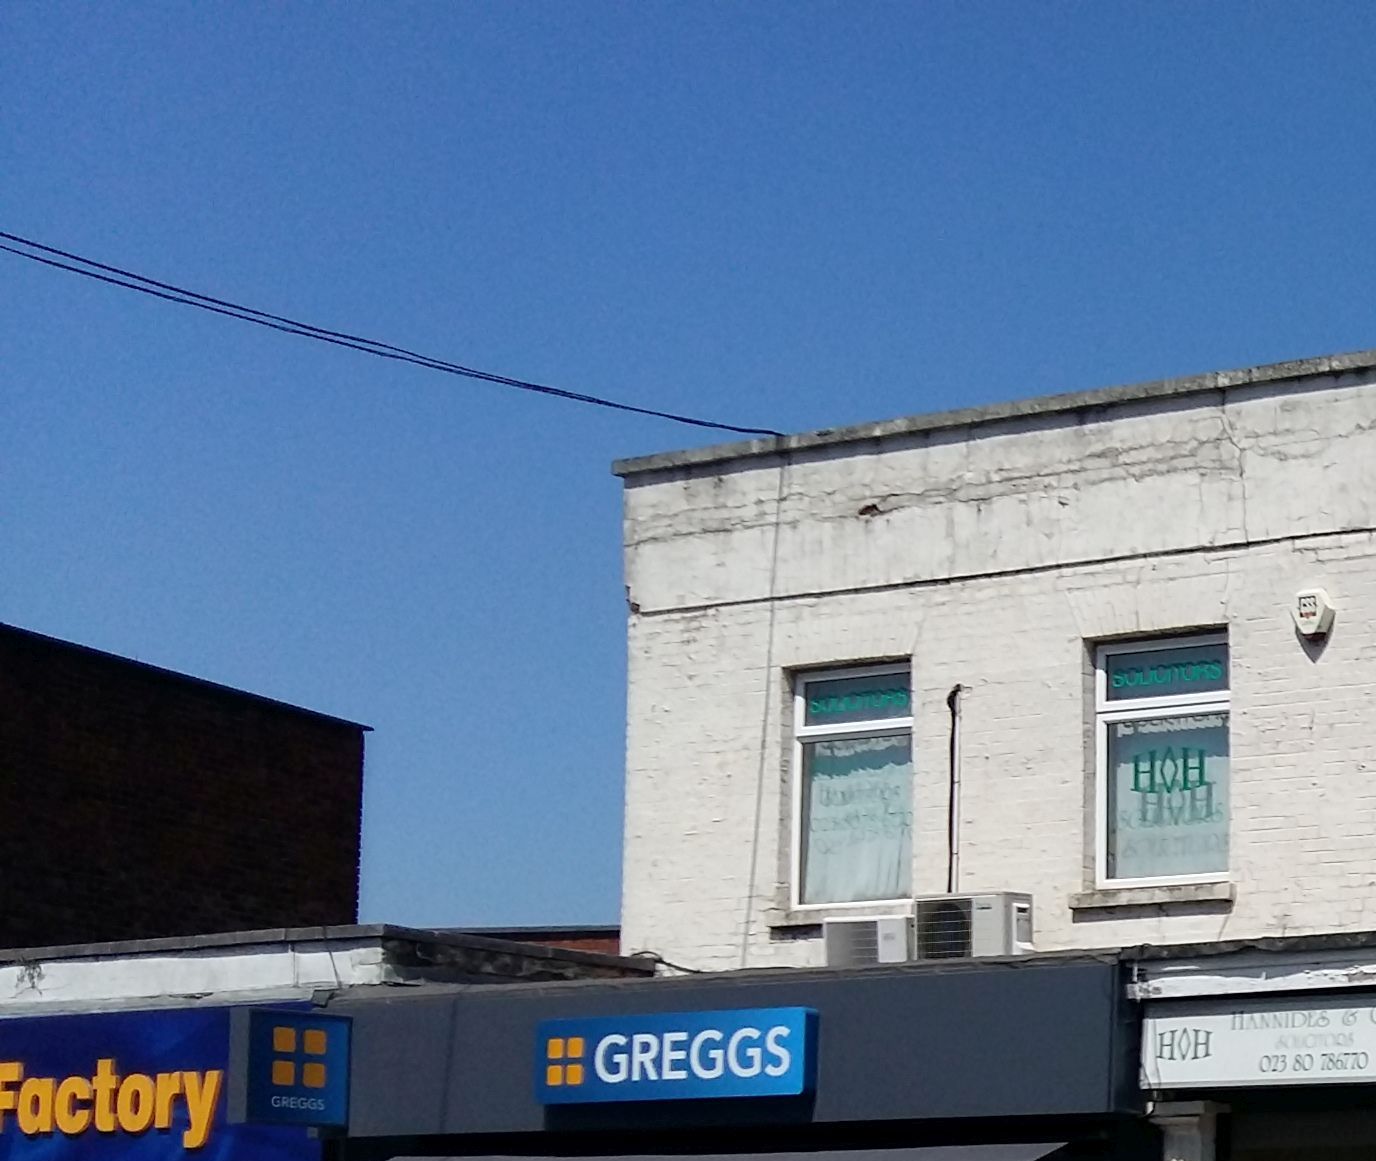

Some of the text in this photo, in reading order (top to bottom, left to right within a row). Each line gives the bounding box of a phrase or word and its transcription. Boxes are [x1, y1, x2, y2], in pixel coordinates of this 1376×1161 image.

[593, 1024, 792, 1084] GREGGS
[1259, 1051, 1370, 1073] 023 80 786770
[0, 1057, 223, 1150] Factory
[271, 1095, 326, 1111] GREGGS
